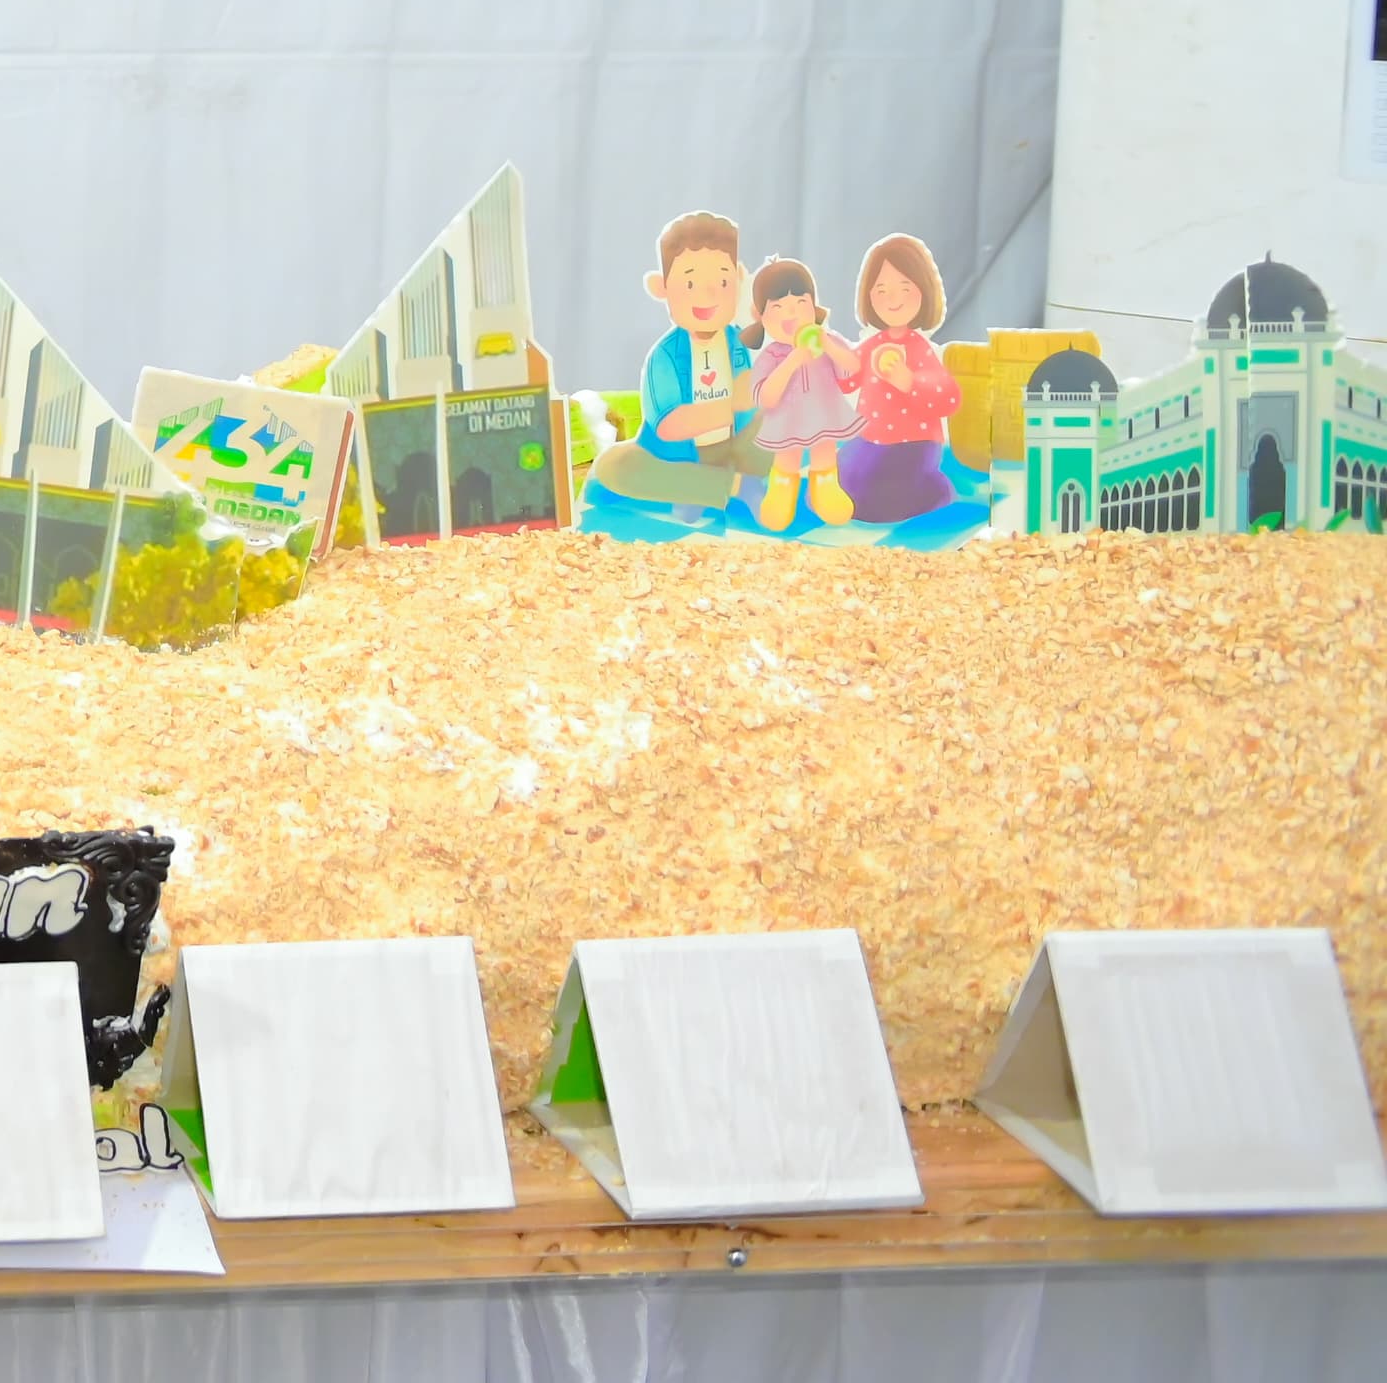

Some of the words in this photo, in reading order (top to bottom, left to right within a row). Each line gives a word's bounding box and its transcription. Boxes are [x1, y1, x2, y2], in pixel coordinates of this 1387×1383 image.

[703, 350, 711, 370] I
[694, 387, 729, 401] Medan
[446, 398, 492, 416] SELAMAT
[493, 395, 535, 411] DATANG
[469, 414, 483, 433] DI
[486, 410, 532, 431] MEDAN
